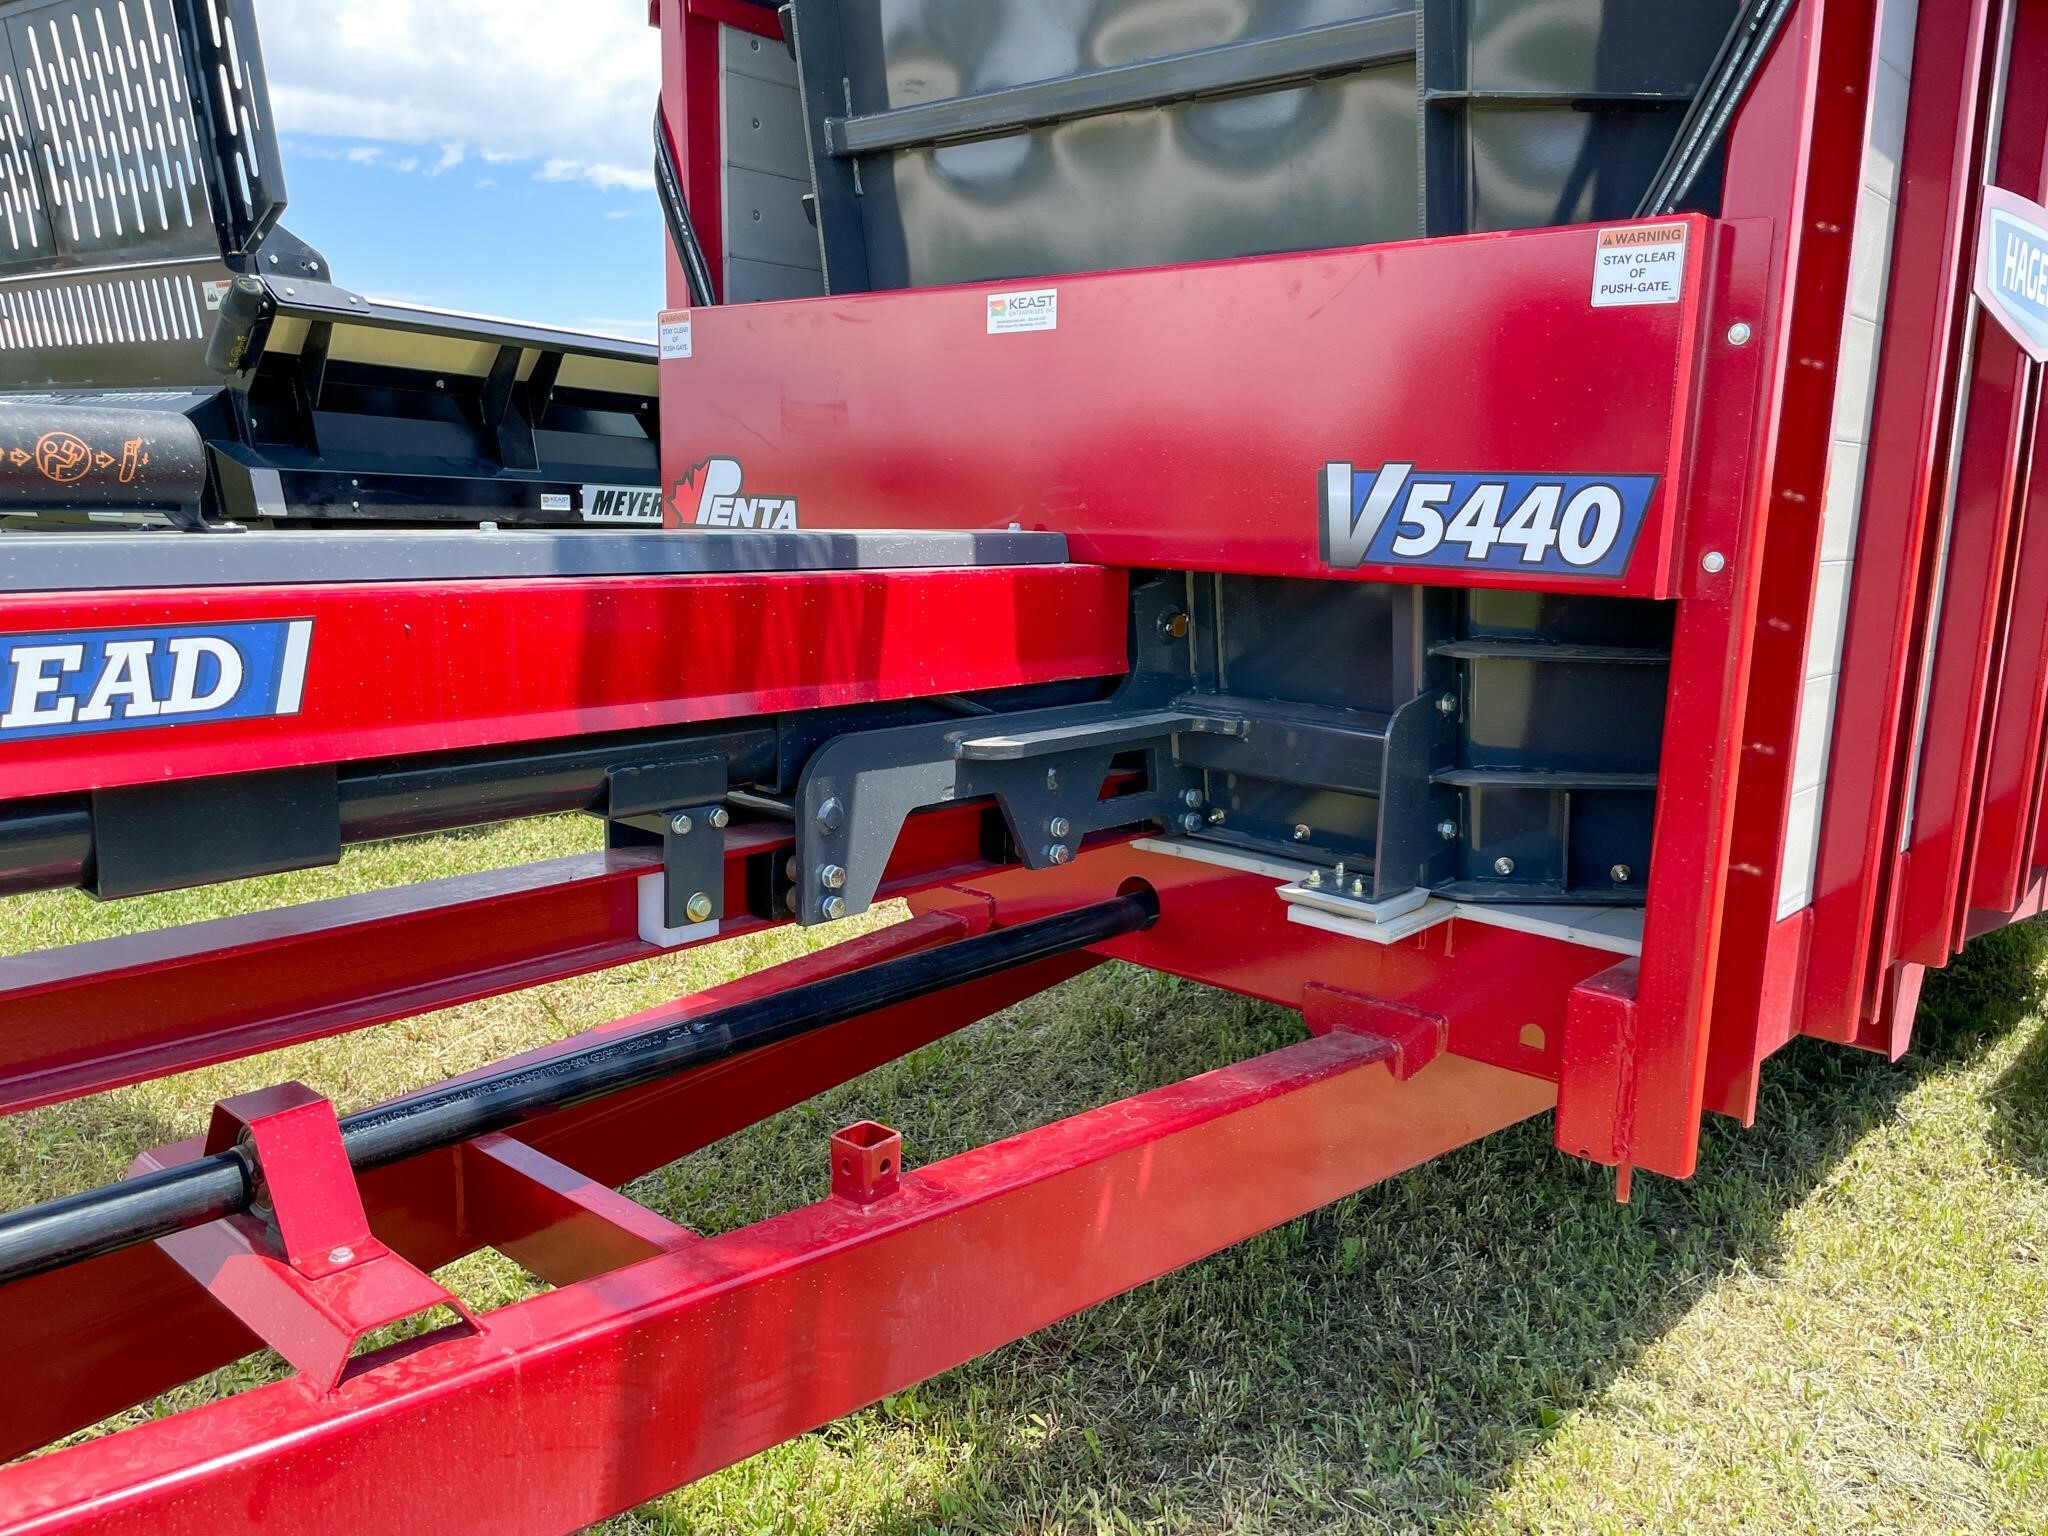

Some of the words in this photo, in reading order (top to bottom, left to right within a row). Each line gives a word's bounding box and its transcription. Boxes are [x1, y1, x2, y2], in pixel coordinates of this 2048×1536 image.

[1615, 229, 1681, 245] WARNING
[1603, 254, 1633, 266] STAY
[1635, 251, 1675, 264] CLEAR
[1629, 268, 1646, 278] OF
[2002, 232, 2048, 307] HAGE
[1600, 281, 1672, 294] PUSH-GATE.
[1009, 295, 1055, 310] KEAST
[696, 459, 797, 528] PENTA
[1320, 462, 1624, 568] V5440
[0, 637, 243, 728] EAD
